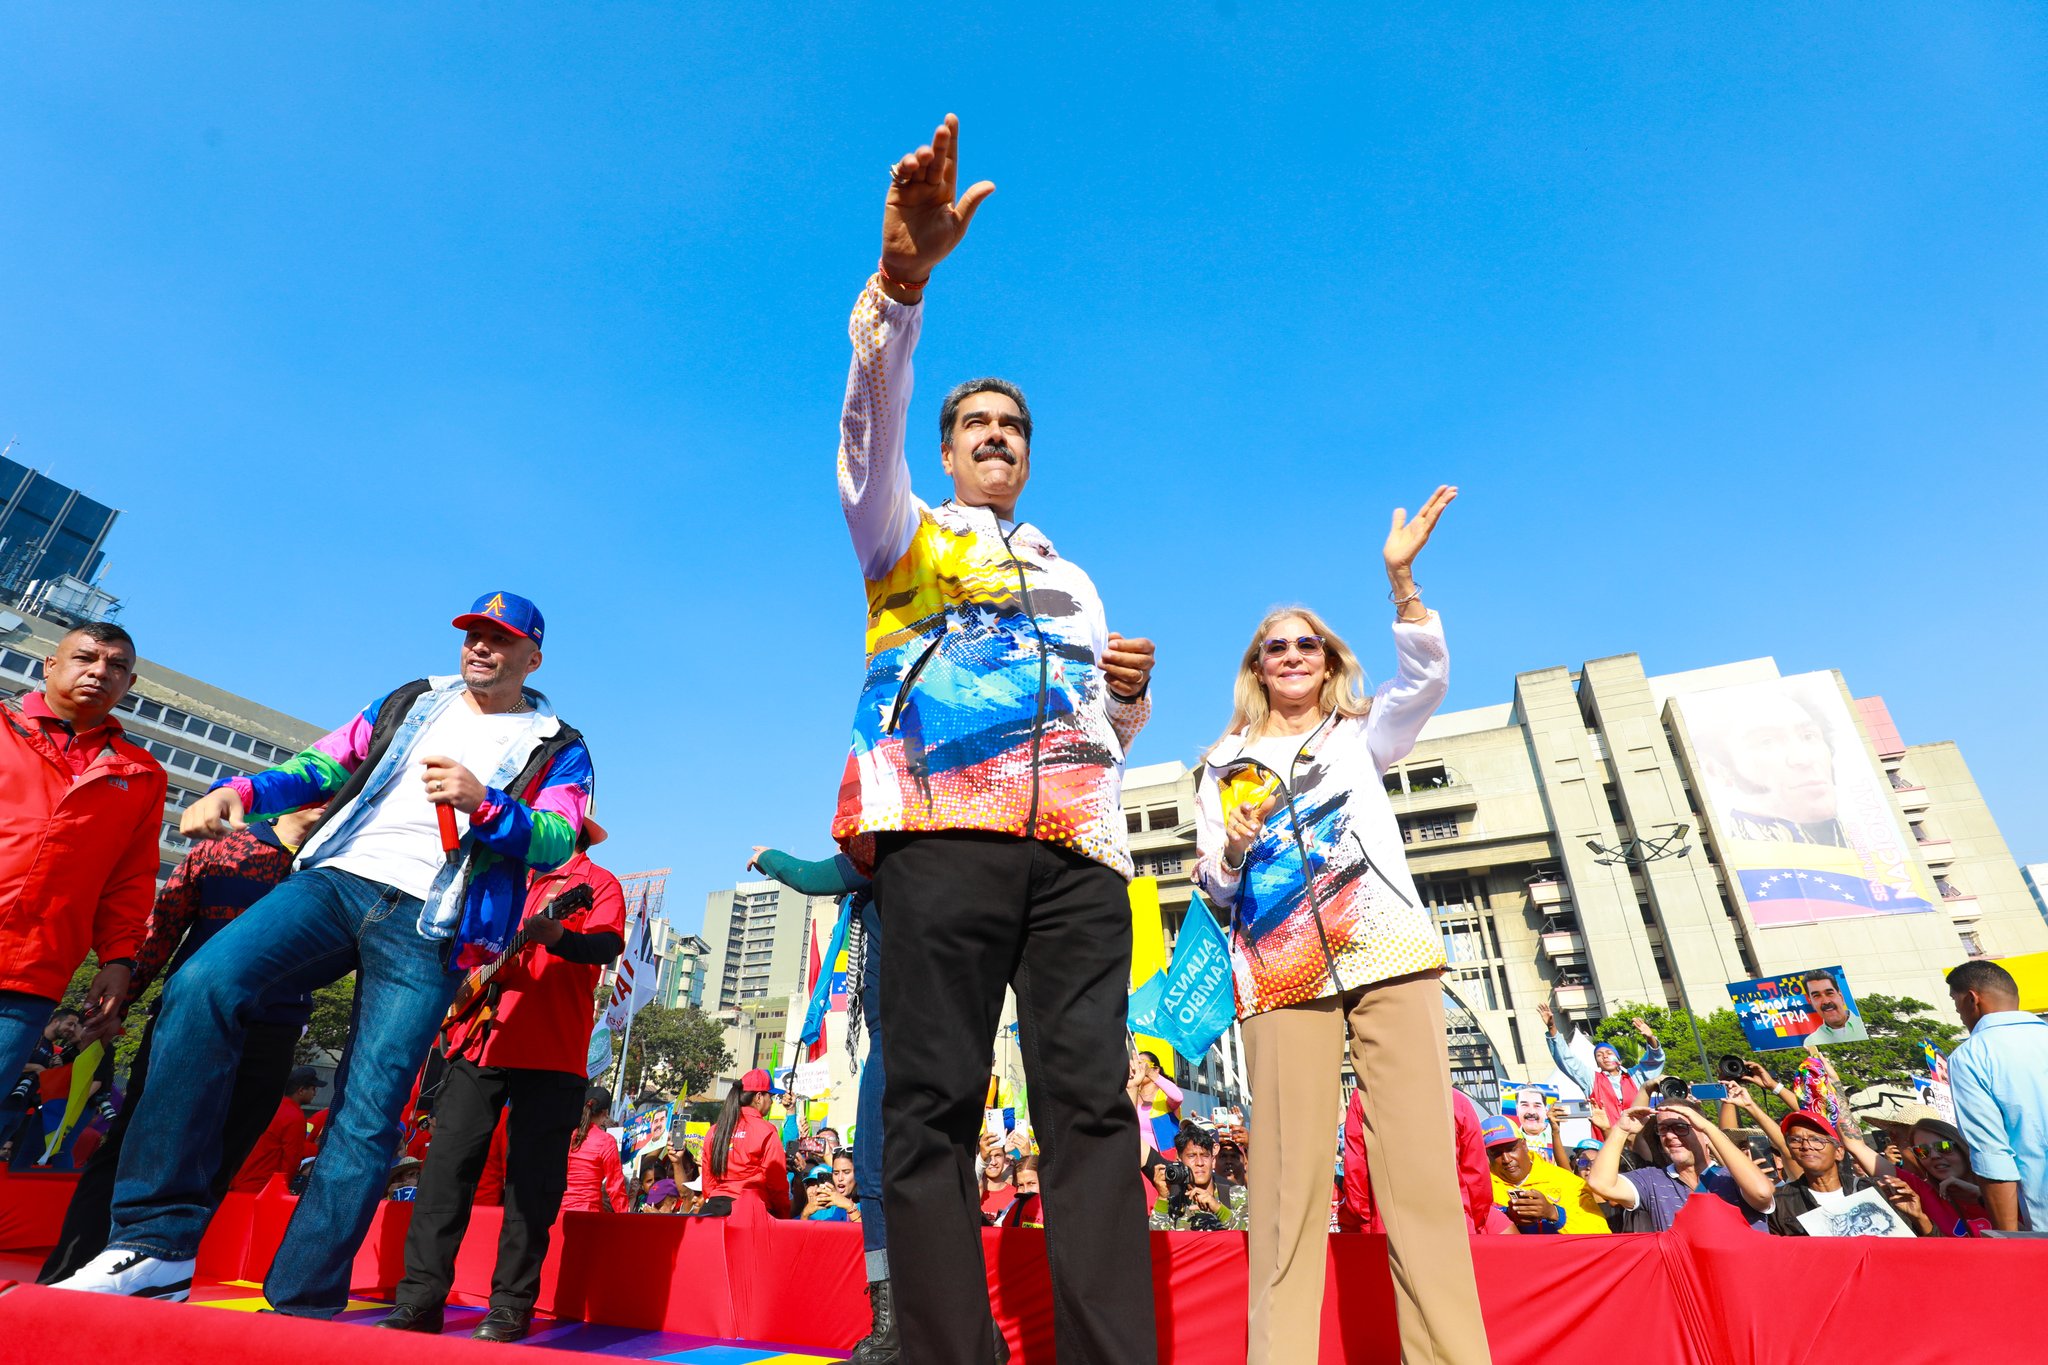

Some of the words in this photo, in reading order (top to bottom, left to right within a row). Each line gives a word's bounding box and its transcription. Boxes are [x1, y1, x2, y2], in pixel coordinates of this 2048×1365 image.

[1850, 777, 1918, 899] NACIONAL
[1848, 821, 1889, 901] SENTIMIENTO
[1739, 981, 1802, 1003] MADURO
[1749, 997, 1789, 1013] amor
[1791, 998, 1803, 1008] de
[1761, 1009, 1810, 1028] PATRIA
